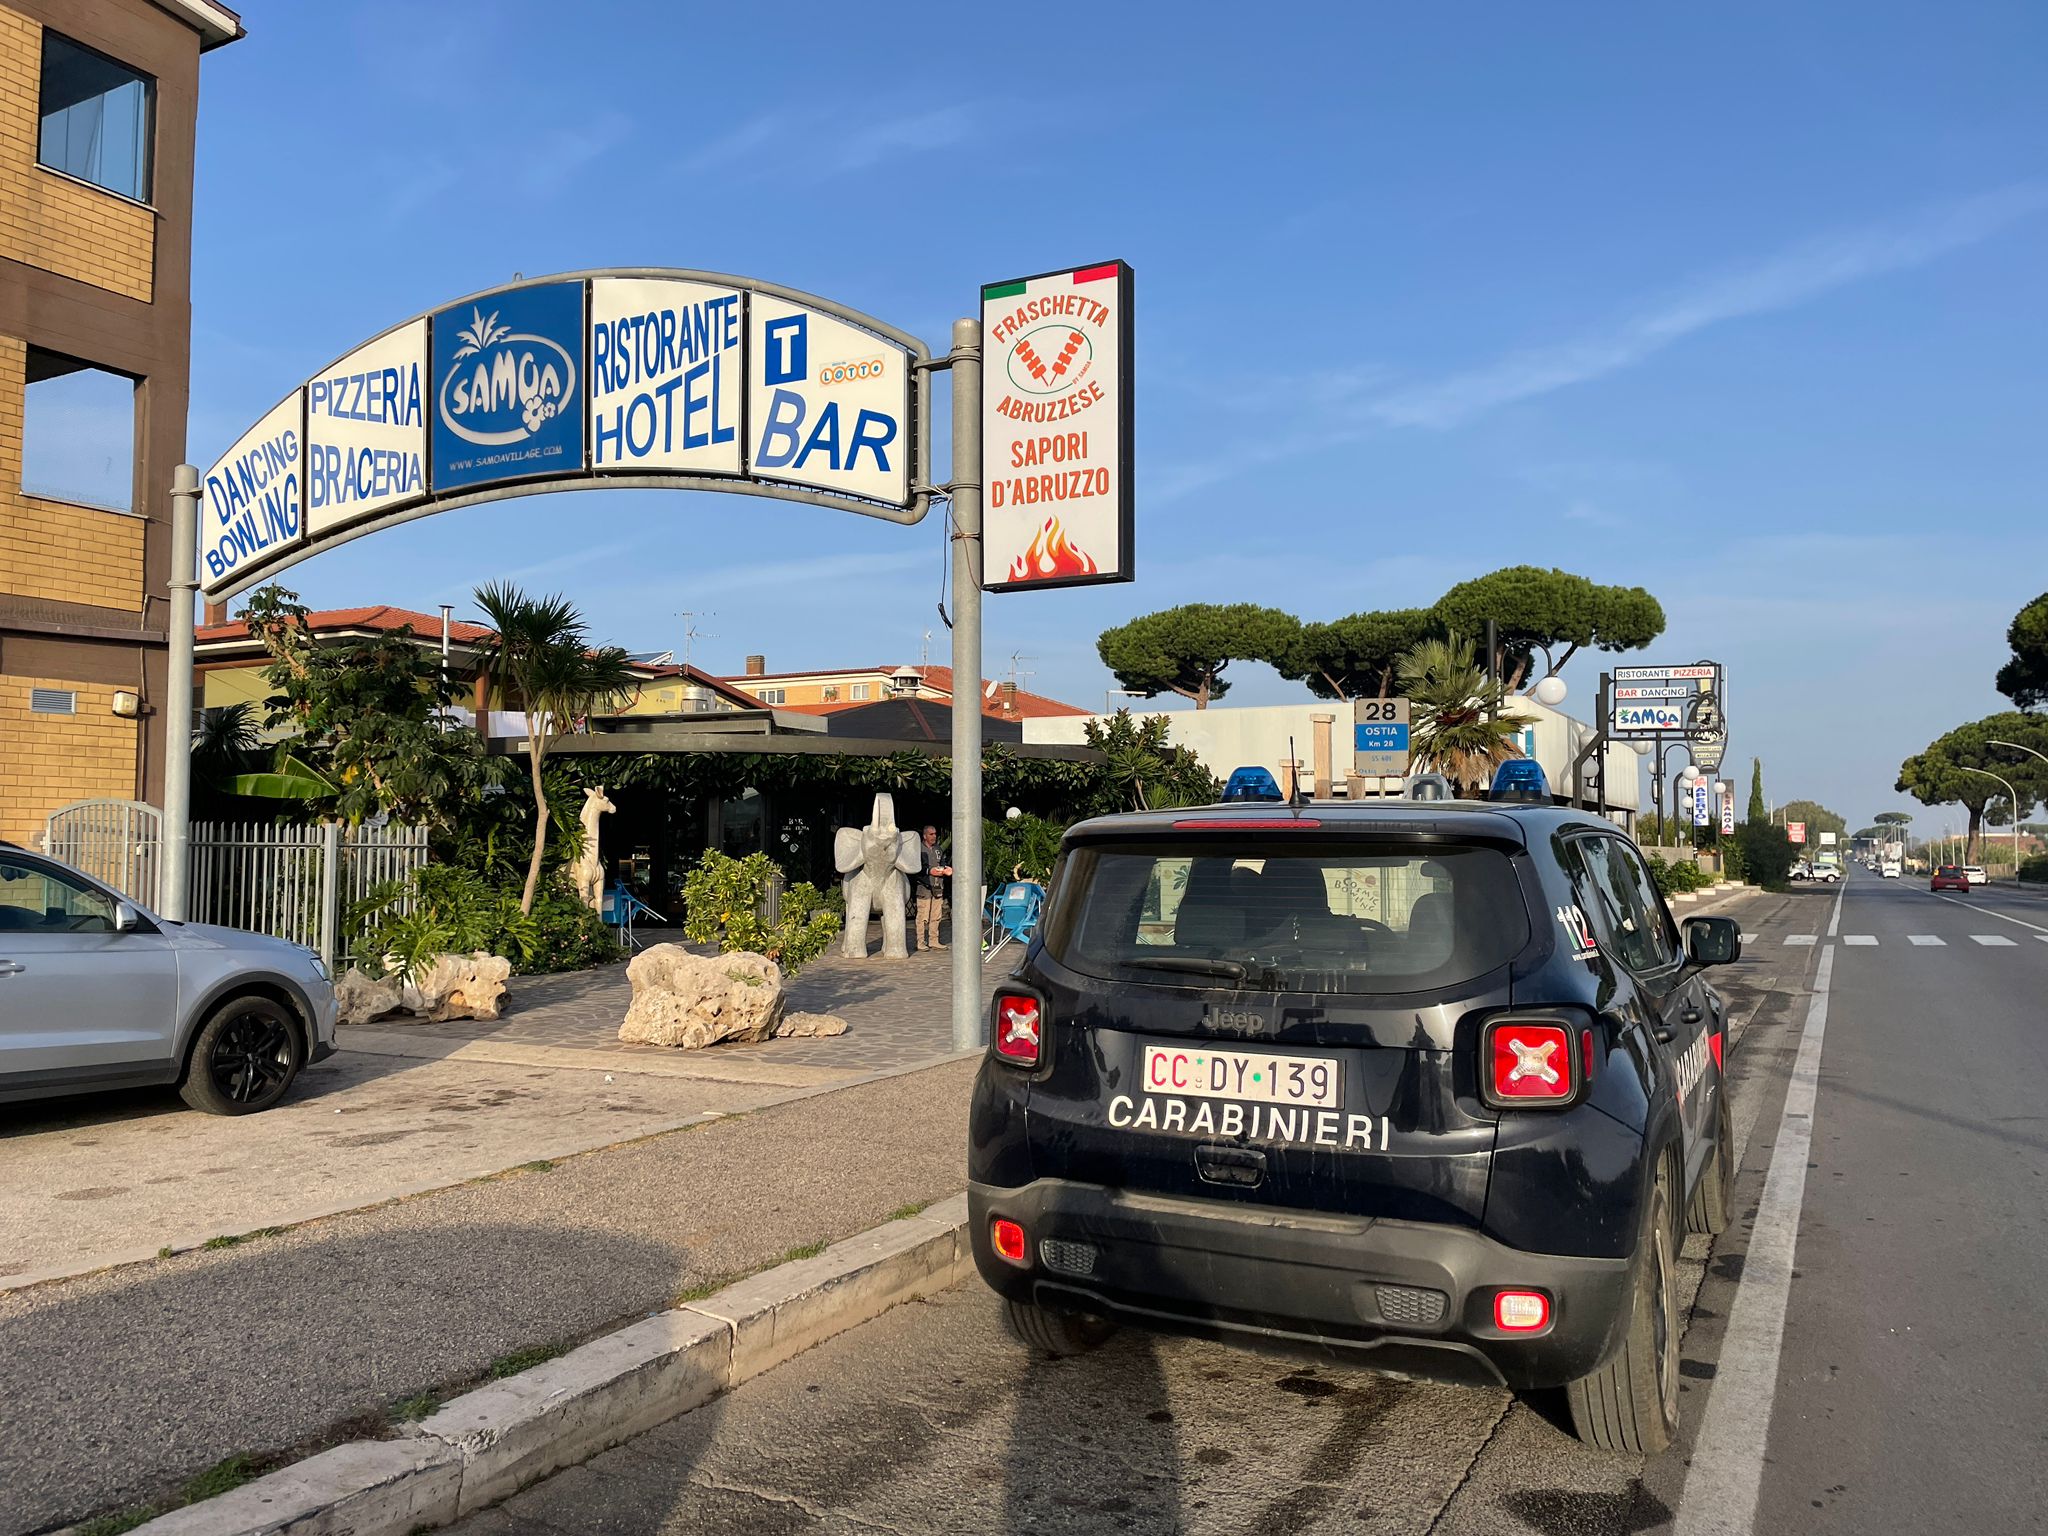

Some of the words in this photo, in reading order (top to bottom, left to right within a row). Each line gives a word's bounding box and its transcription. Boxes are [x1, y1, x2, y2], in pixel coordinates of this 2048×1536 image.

[992, 295, 1110, 344] FRASCHETTA
[593, 294, 738, 399] RISTORANTE
[773, 325, 800, 376] T
[452, 350, 561, 415] SAMOA
[820, 360, 884, 385] LOTTO
[311, 362, 422, 428] PIZZERIA
[596, 353, 735, 464] HOTEL
[996, 380, 1105, 423] ABRUZZESE
[755, 388, 898, 472] BAR
[1011, 431, 1088, 468] SAPORI
[206, 430, 299, 527] DANCING
[310, 443, 423, 509] BRACERIA
[449, 445, 563, 472] WWW.SAMOAVILLAGE.COM
[992, 467, 1110, 508] D'ABRUZZO
[205, 473, 299, 579] BOWLING
[1617, 669, 1671, 679] RISTORANTE
[1673, 668, 1712, 677] PIZZERIA
[1617, 689, 1637, 697] BAR
[1641, 688, 1685, 697] DANCING
[1365, 727, 1398, 736] OSTIA
[1366, 702, 1397, 721] 28
[1620, 708, 1679, 725] SAMOA
[1695, 787, 1707, 819] APERTO
[1335, 880, 1375, 912] BOWLING
[1343, 876, 1379, 906] COSMIC
[1557, 904, 1597, 950] 112
[1202, 1007, 1264, 1036] Jeep
[1151, 1053, 1188, 1088] CC
[1210, 1057, 1250, 1094] DY
[1268, 1061, 1329, 1100] 139
[1108, 1095, 1390, 1151] CARABINIERI
